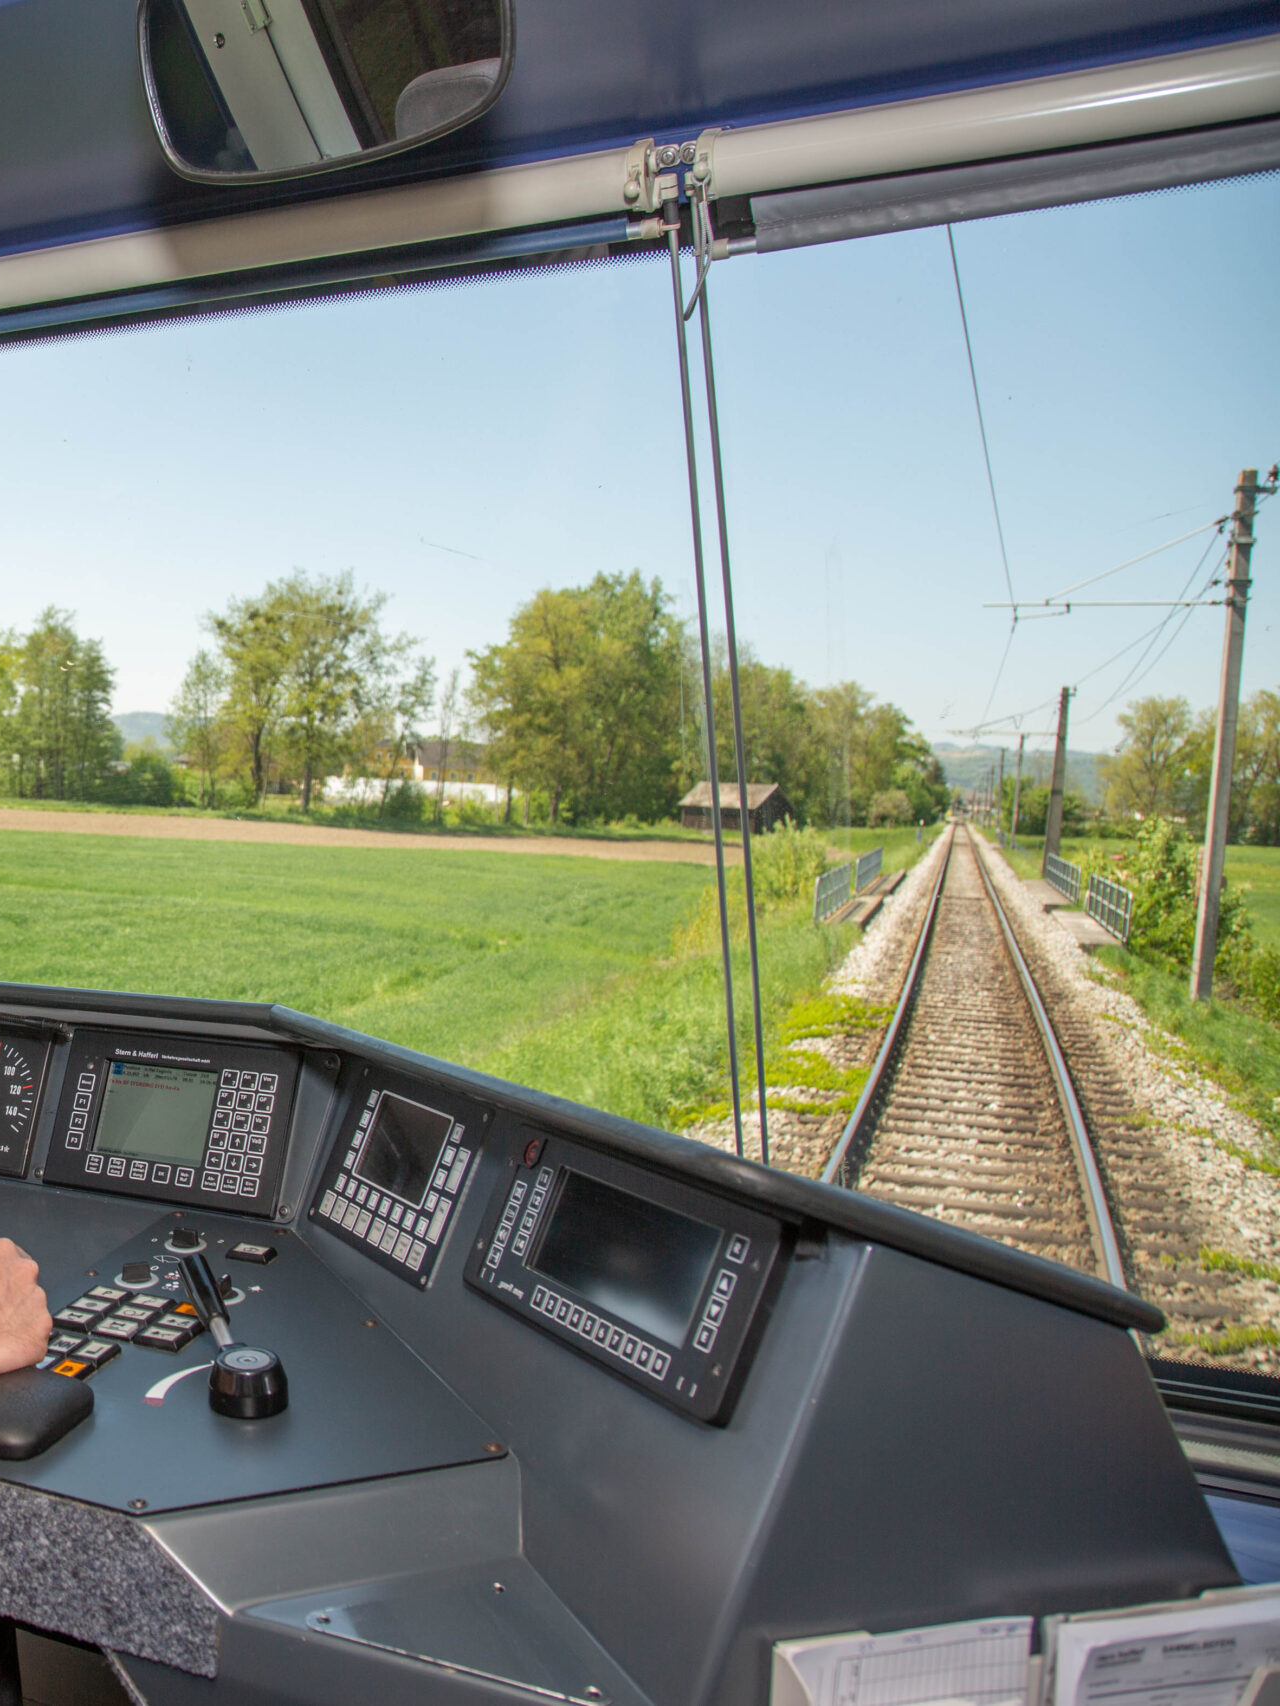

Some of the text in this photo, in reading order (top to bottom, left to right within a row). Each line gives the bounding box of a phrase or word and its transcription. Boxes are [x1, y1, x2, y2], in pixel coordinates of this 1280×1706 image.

[115, 1048, 132, 1056] Stern
[138, 1050, 159, 1059] Hafferl
[4, 1065, 16, 1076] 100
[10, 1084, 22, 1095] 120
[5, 1105, 18, 1116] 140
[733, 1242, 742, 1255] R
[536, 1293, 541, 1303] 1
[548, 1300, 554, 1310] 2
[560, 1306, 567, 1317] 3
[572, 1313, 579, 1324] 4
[585, 1320, 592, 1331] 5
[598, 1327, 605, 1338] 6
[700, 1330, 709, 1344] E
[612, 1335, 619, 1346] 7
[626, 1343, 633, 1354] 8
[641, 1350, 648, 1362] 9
[655, 1359, 663, 1371] 0
